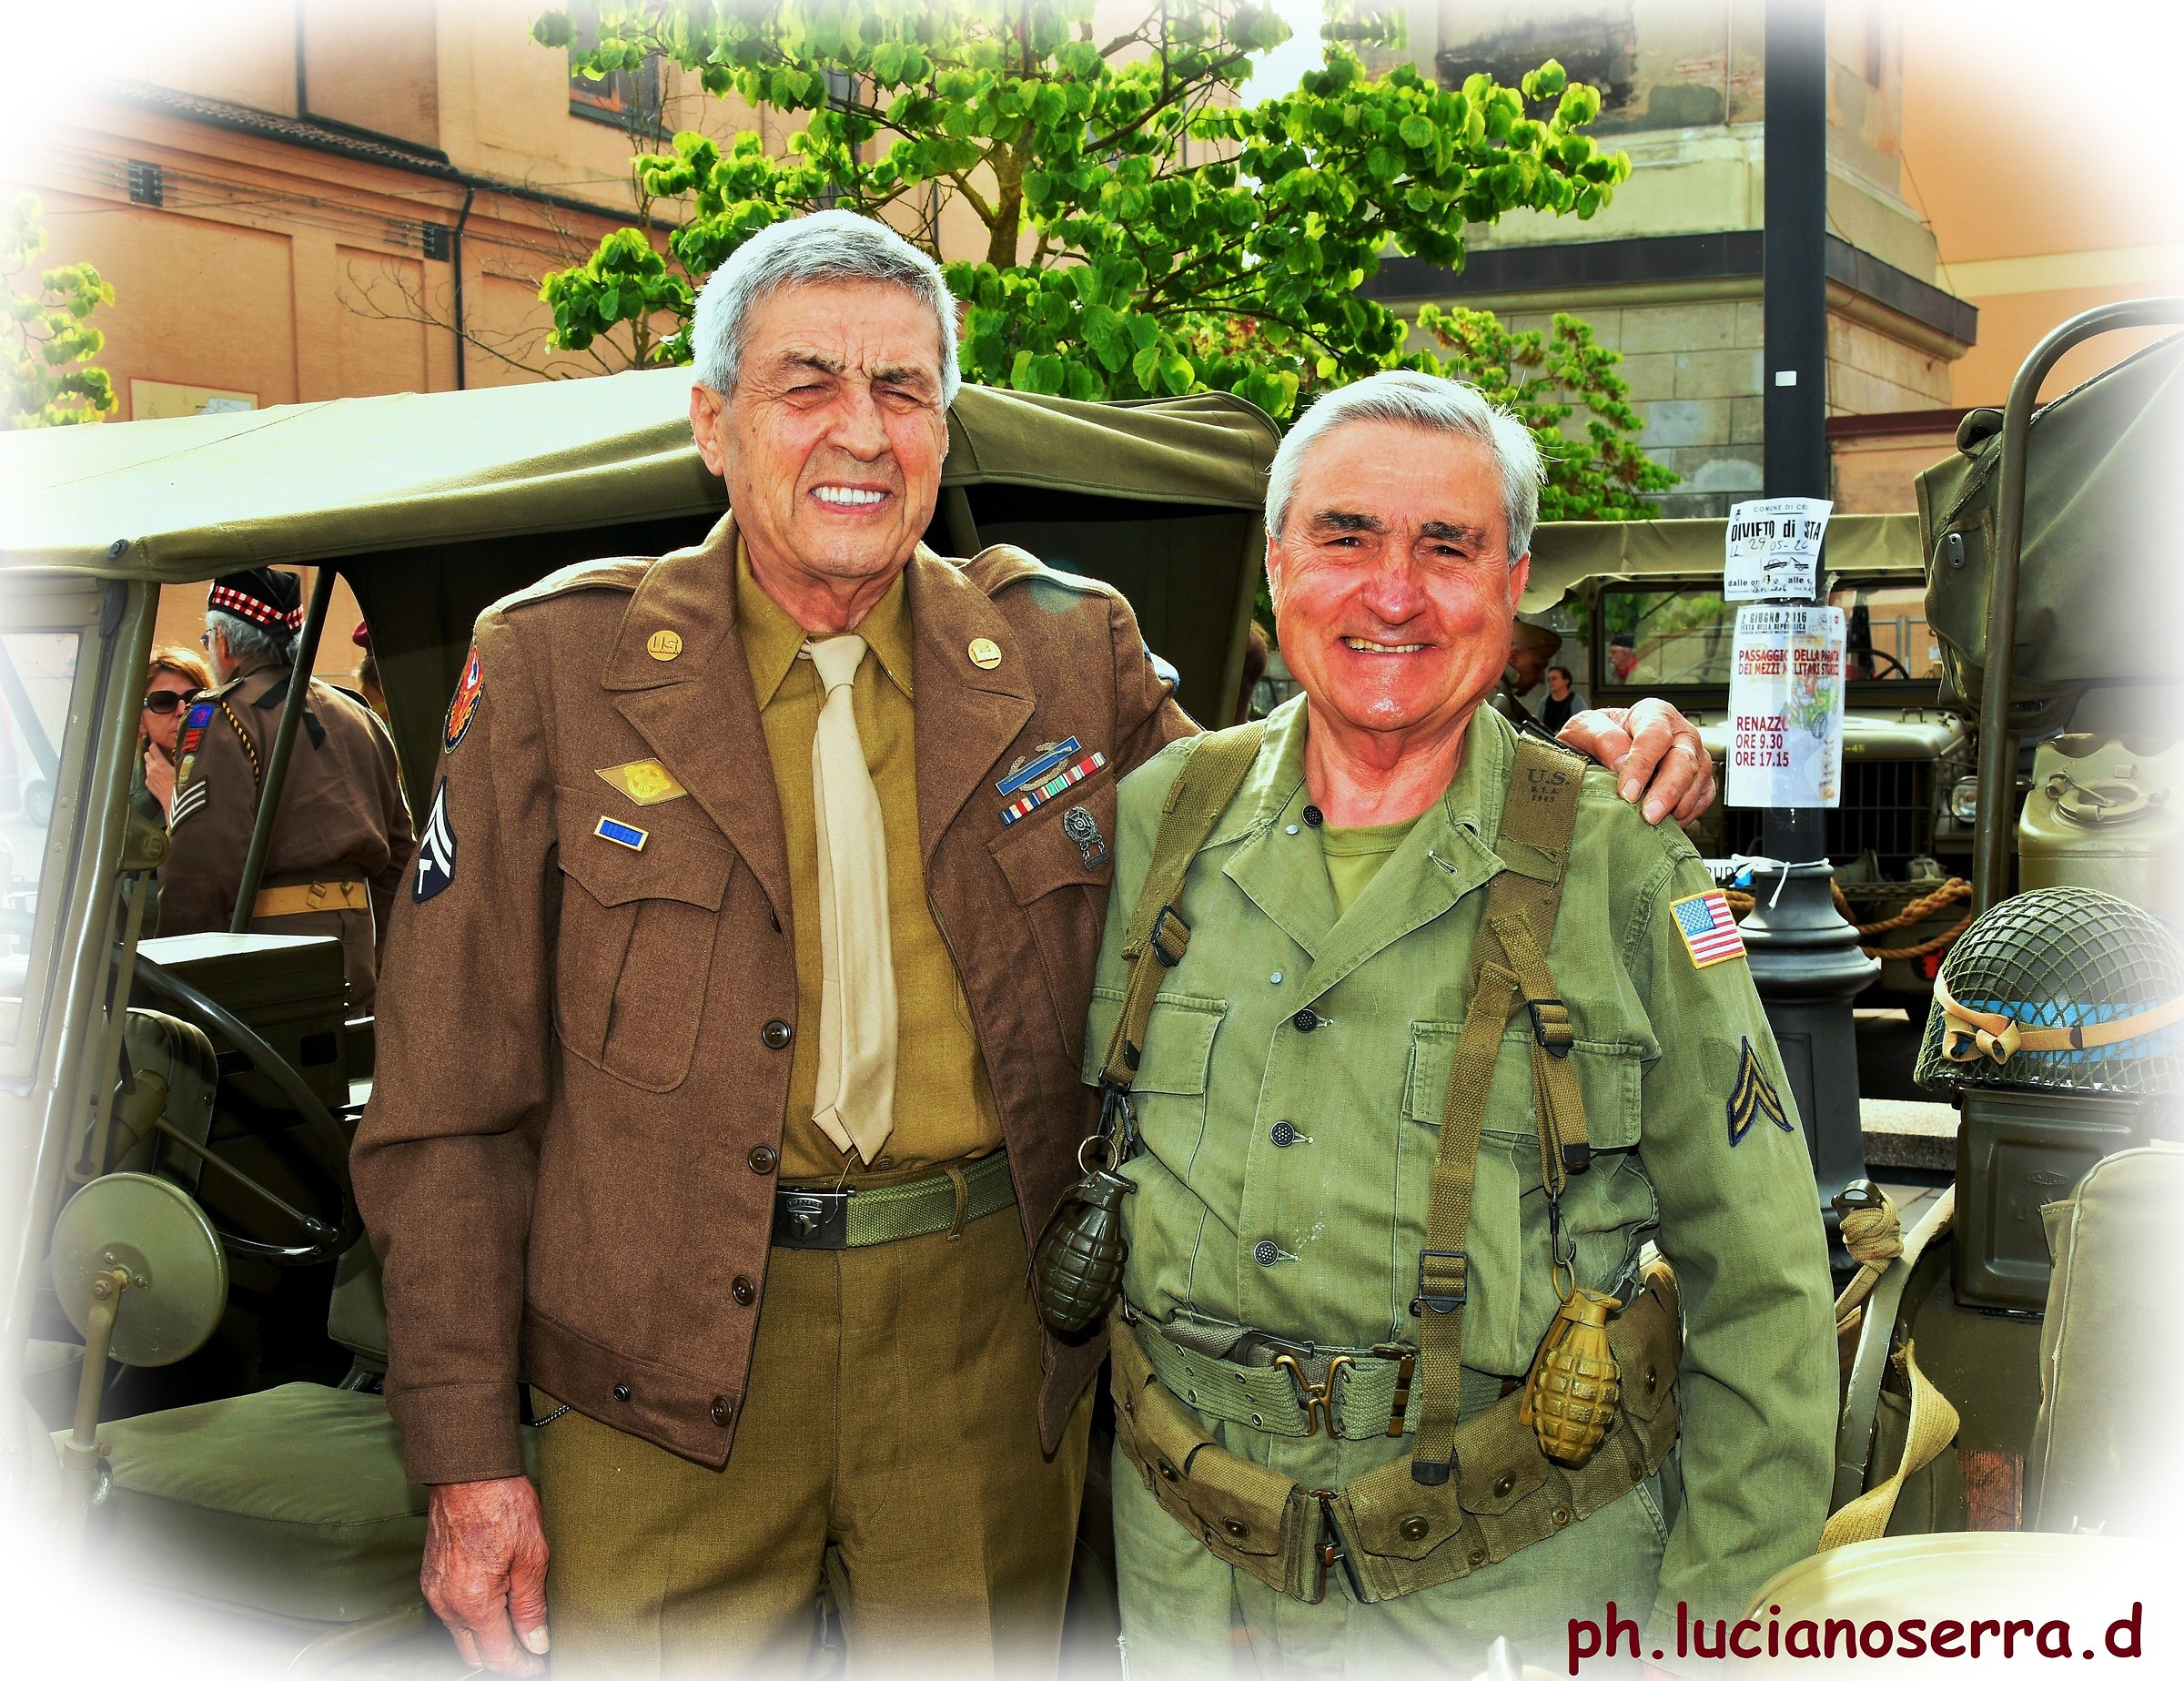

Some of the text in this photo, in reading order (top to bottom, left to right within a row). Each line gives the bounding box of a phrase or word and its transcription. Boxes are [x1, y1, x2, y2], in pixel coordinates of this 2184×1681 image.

[1731, 520, 1775, 542] DIVIETO
[1783, 519, 1795, 538] di
[1727, 578, 1748, 587] dalle
[1787, 576, 1805, 584] alle
[1741, 613, 1746, 623] 2
[1738, 649, 1788, 662] PASSAGGIO
[1794, 649, 1819, 662] DELLA
[1738, 663, 1753, 674] DEI
[1754, 663, 1780, 674] MEZZI
[1783, 663, 1820, 674] MLITARI
[1736, 715, 1792, 732] RENAZZO
[1735, 734, 1784, 749] ORE 9.30
[1735, 751, 1790, 767] ORE 17.15
